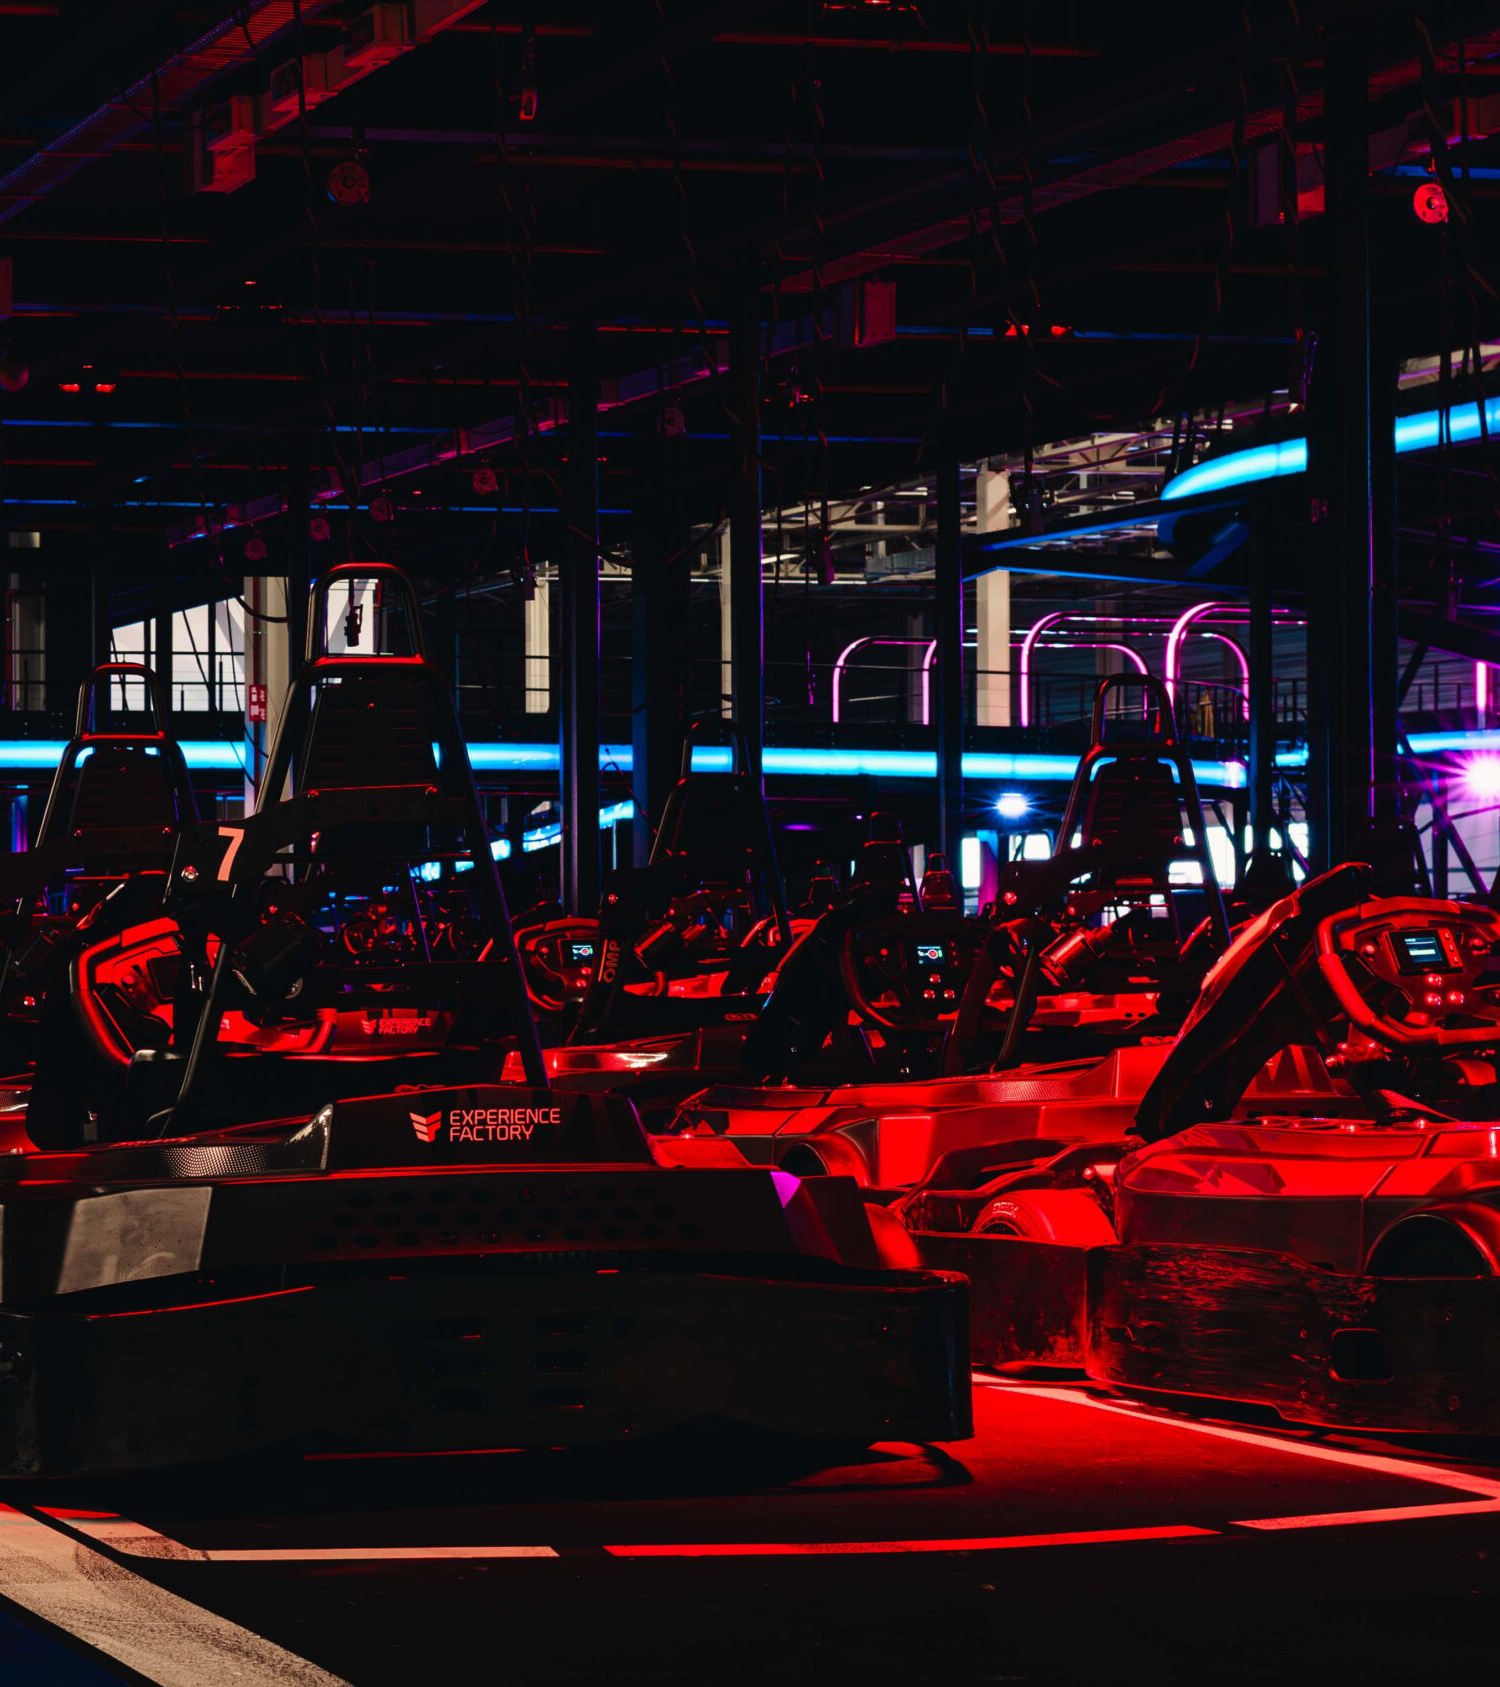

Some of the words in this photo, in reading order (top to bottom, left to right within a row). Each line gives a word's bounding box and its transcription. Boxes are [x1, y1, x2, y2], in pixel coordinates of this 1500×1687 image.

[217, 826, 245, 881] 7
[603, 938, 621, 984] OMP
[378, 1025, 418, 1035] FACTORY
[379, 1017, 432, 1027] EXPERIENCE
[449, 1107, 562, 1126] EXPERIENCE
[449, 1125, 535, 1143] FACTORY
